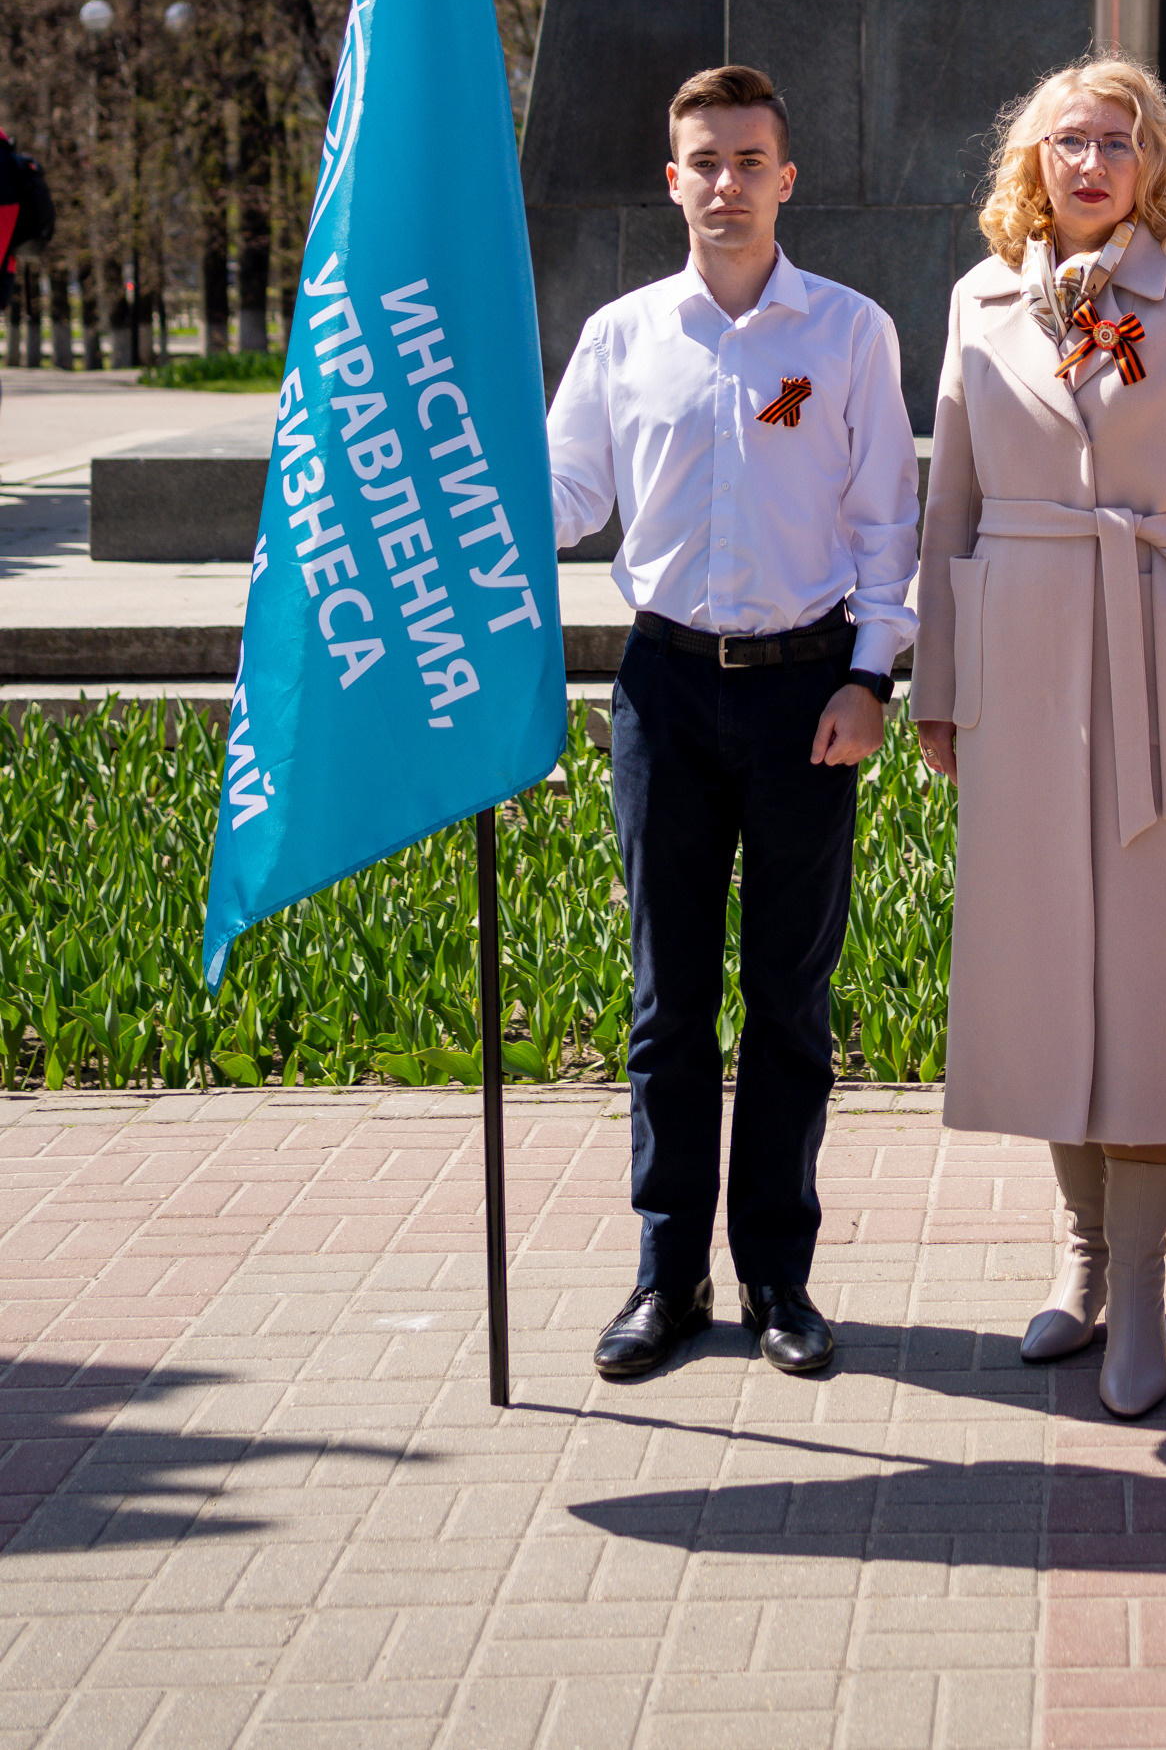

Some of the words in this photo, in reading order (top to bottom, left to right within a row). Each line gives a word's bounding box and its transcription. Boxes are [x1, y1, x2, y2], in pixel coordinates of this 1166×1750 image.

[277, 366, 386, 690] БИЗНЕСА
[303, 251, 481, 728] УПРАВЛЕНИЯ,
[380, 278, 542, 634] ИНСТИТУТ
